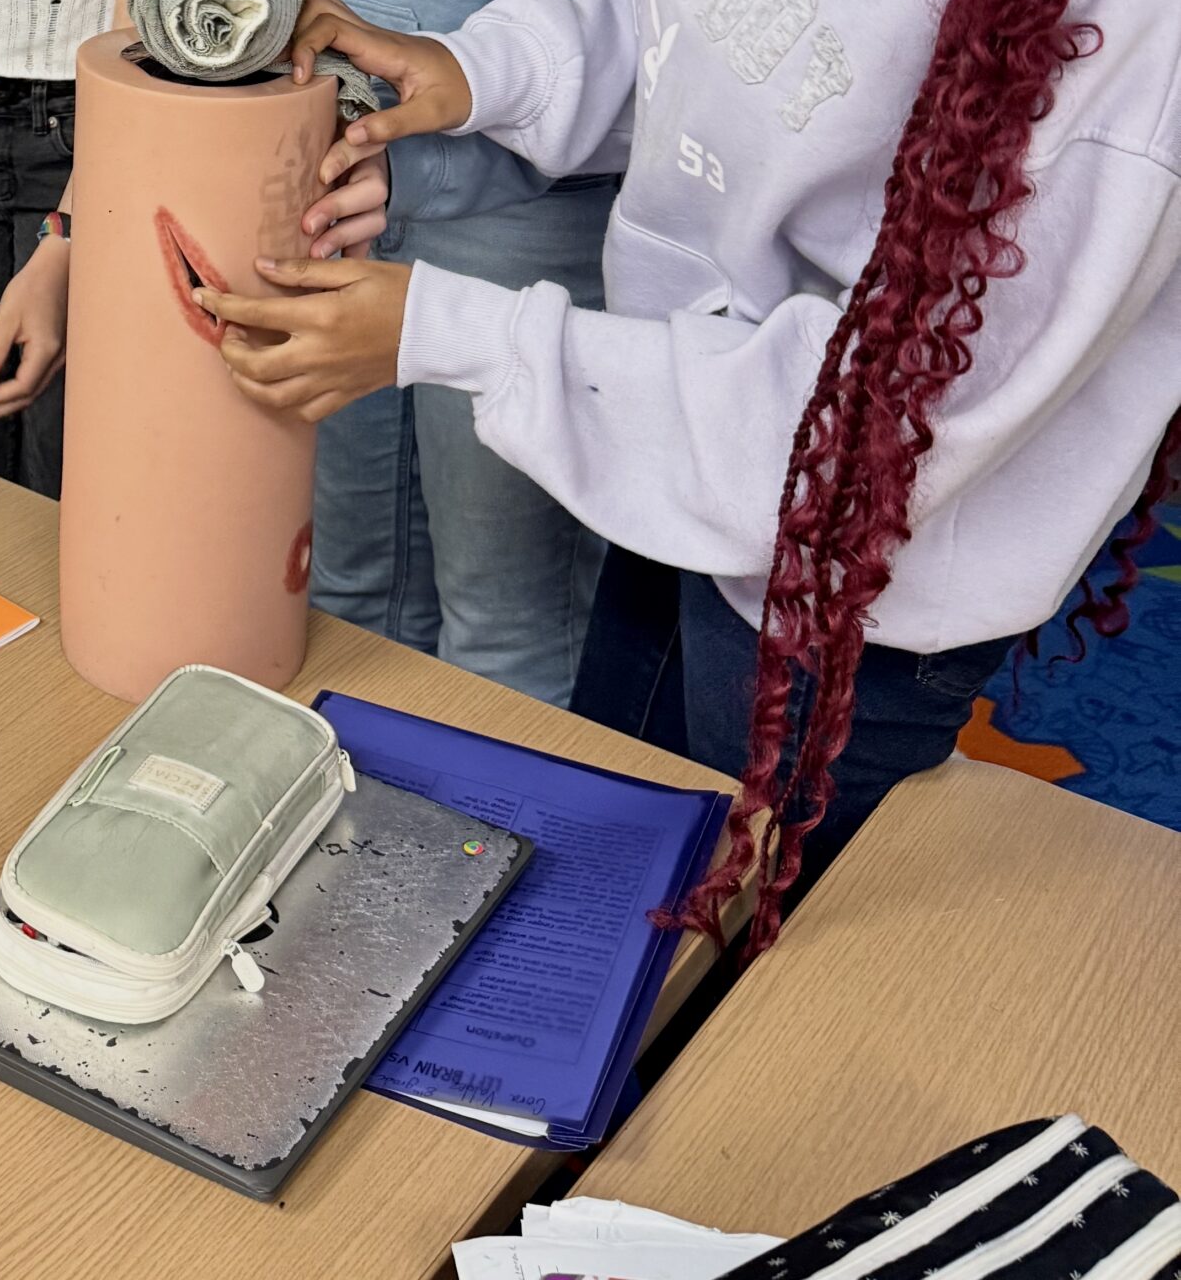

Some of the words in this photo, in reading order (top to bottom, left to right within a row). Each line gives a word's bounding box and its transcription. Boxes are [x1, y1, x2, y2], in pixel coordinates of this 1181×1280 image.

[465, 1024, 537, 1049] Question
[412, 1059, 465, 1086] BRAIN
[510, 1093, 546, 1115] Cora
